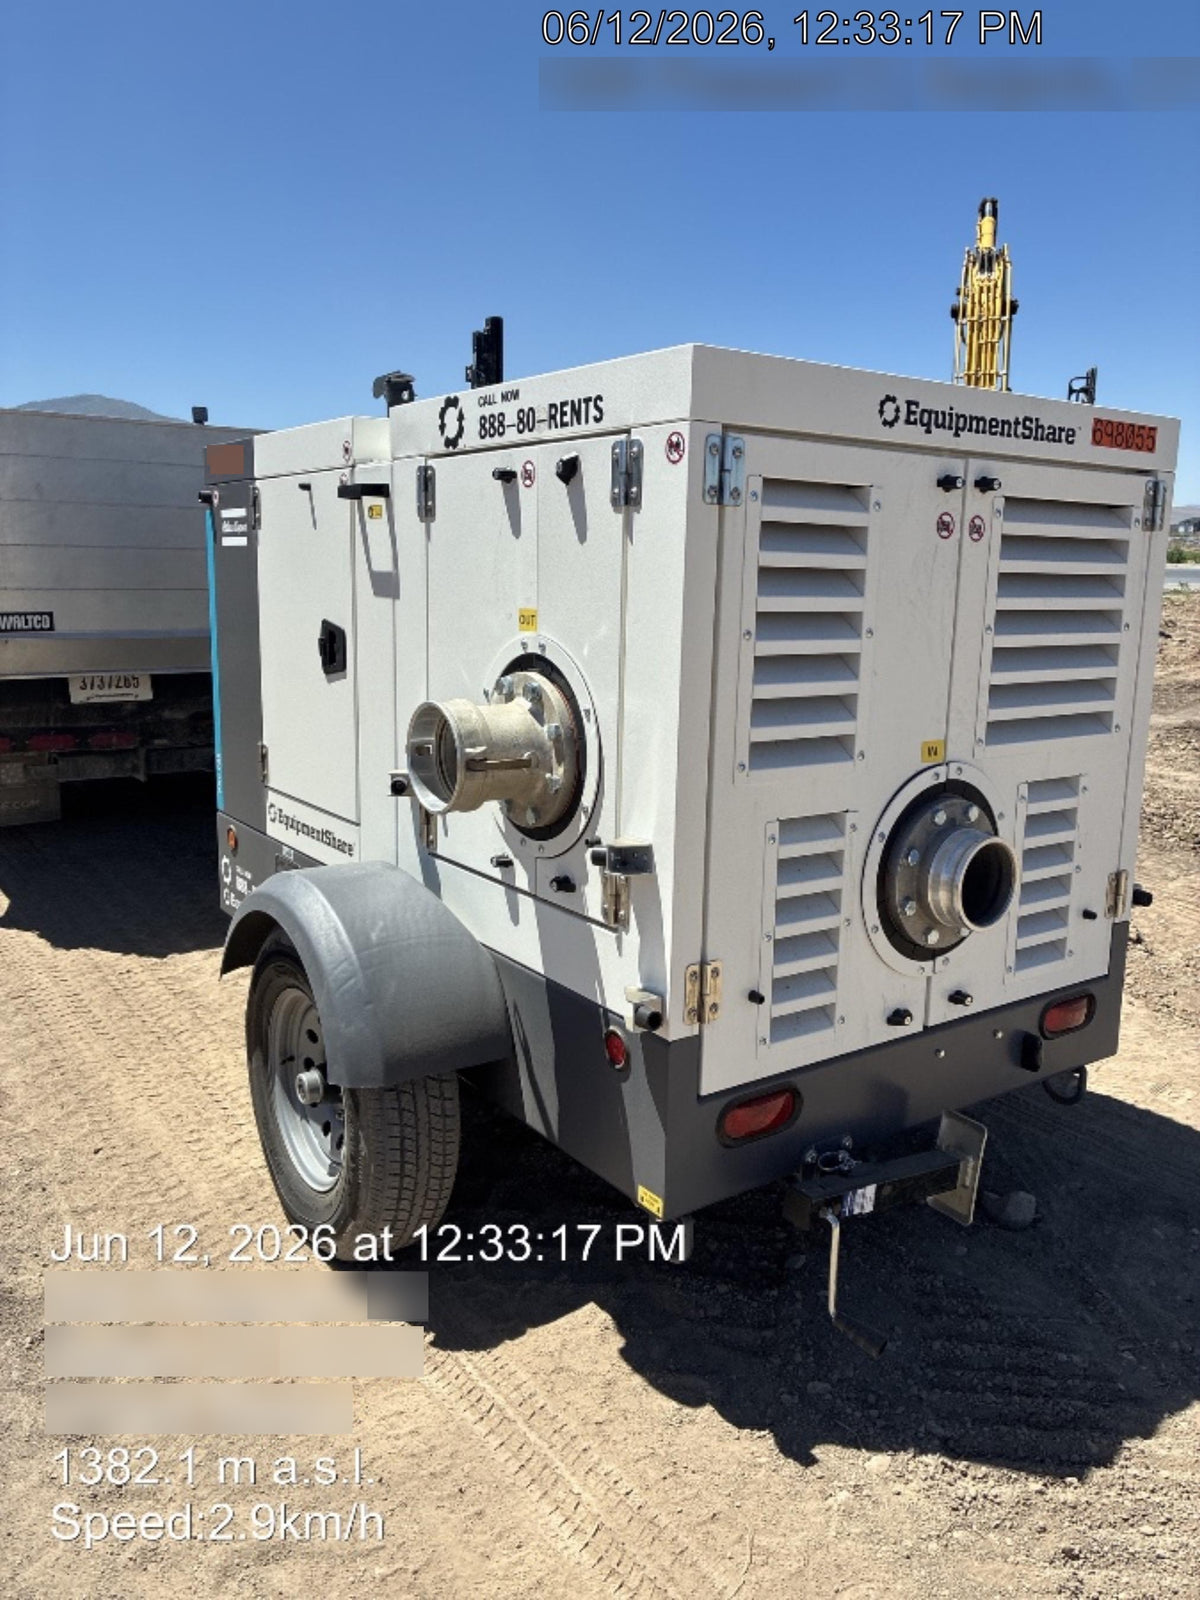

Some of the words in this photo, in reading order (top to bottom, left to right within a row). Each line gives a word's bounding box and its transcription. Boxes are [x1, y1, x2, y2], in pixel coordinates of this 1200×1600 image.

[478, 393, 497, 407] CALL
[501, 389, 520, 402] NOW
[479, 395, 604, 439] 888-80-RENTS
[904, 400, 1077, 445] EquipmentShare
[1092, 418, 1157, 453] 698055
[277, 808, 355, 857] EquipmentShare
